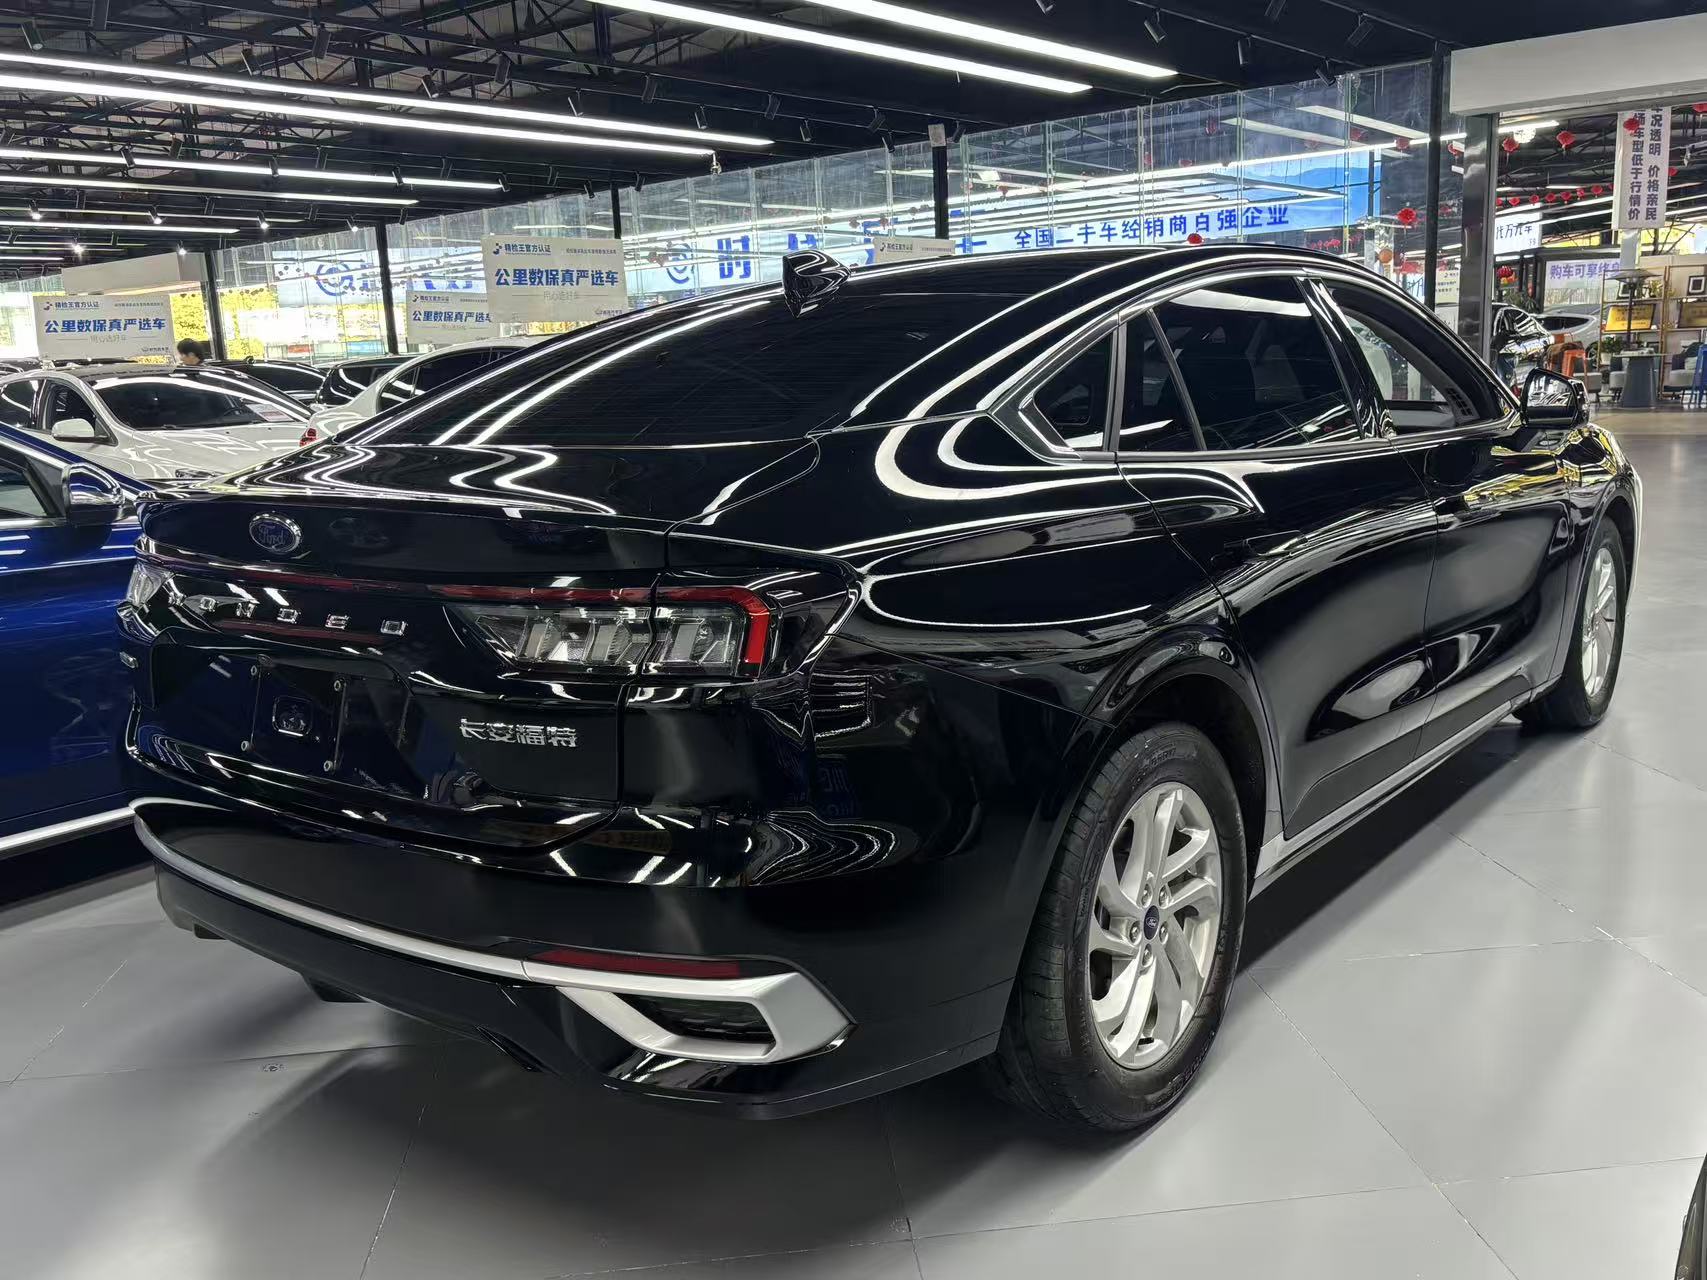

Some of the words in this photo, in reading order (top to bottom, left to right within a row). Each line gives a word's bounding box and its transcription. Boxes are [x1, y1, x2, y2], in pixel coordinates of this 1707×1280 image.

[1628, 108, 1646, 220] 场车型低于行情价
[1645, 164, 1660, 220] 价格亲民
[494, 268, 619, 286] 公里数保真严选车
[44, 317, 167, 334] 公里数保真严选车
[459, 718, 578, 748] 长安福特
